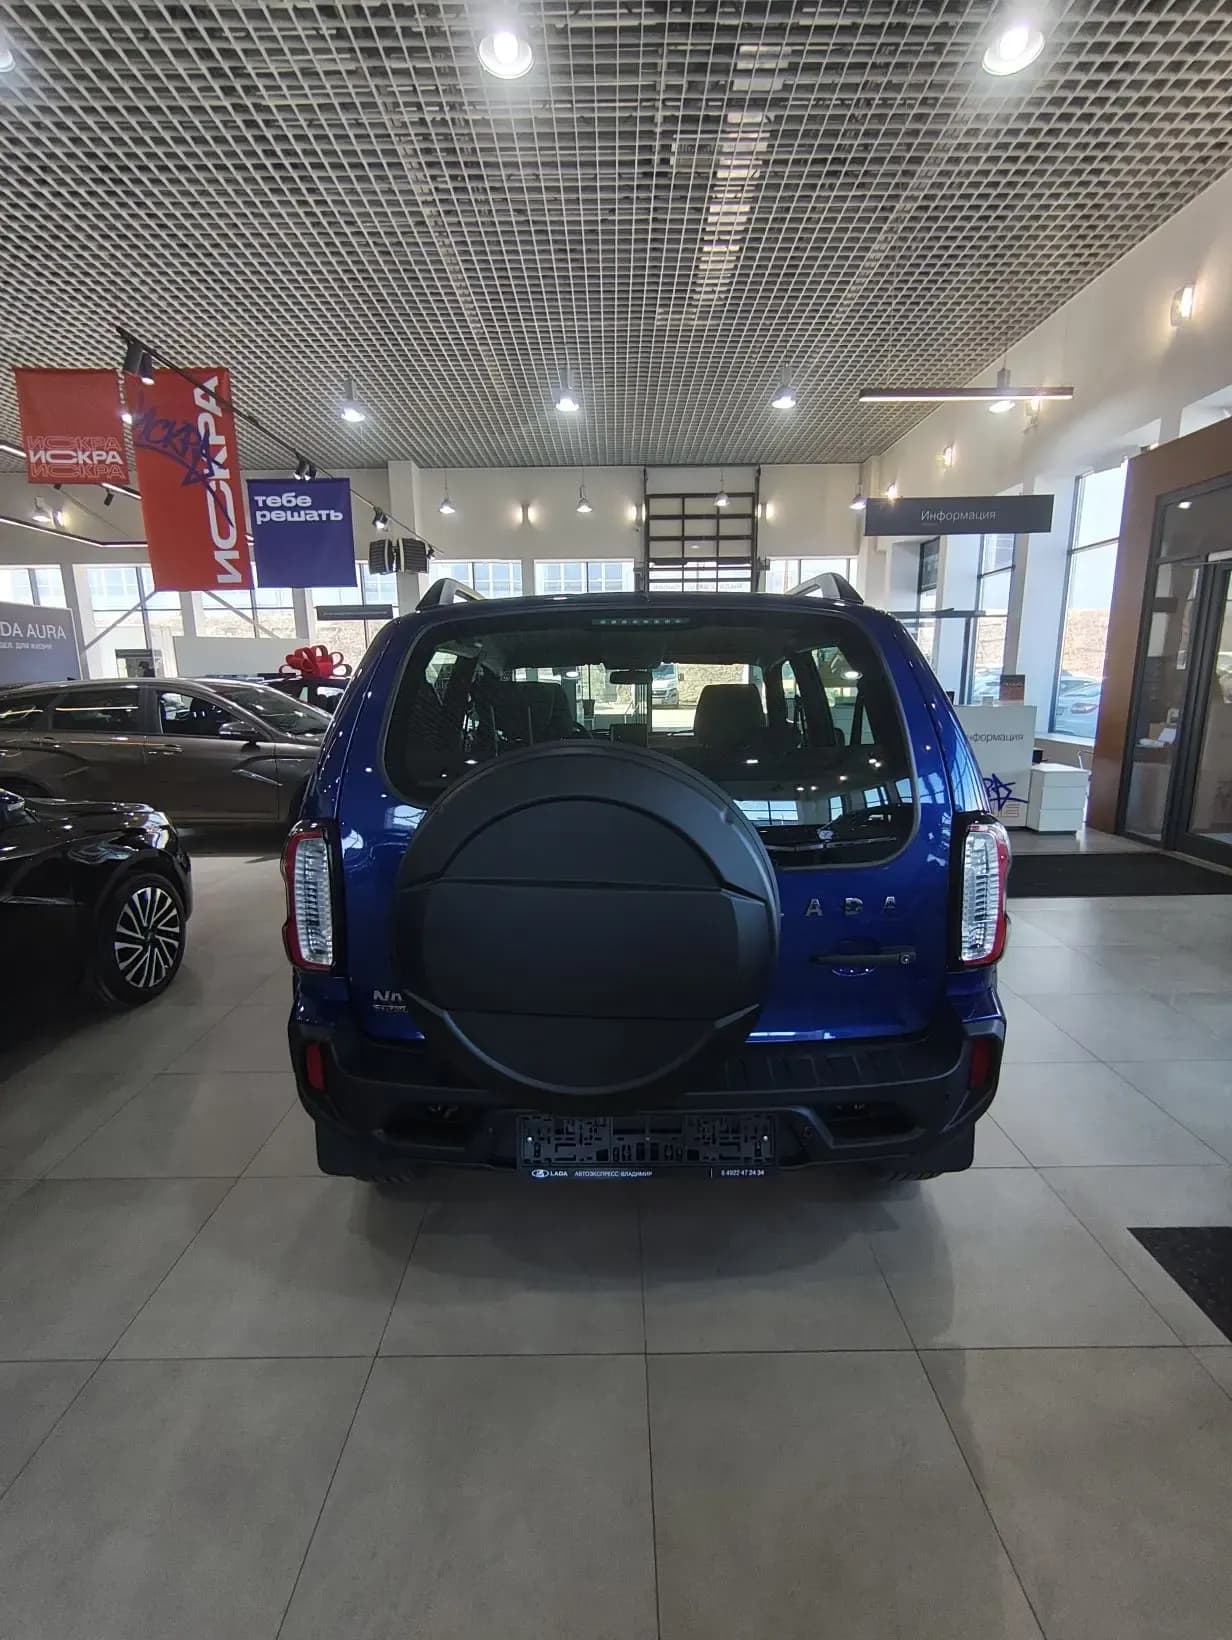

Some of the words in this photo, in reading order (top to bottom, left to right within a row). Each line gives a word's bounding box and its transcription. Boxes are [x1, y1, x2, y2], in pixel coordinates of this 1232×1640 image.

[27, 435, 122, 452] ИСКРА
[29, 450, 124, 465] ИСКРА
[31, 464, 127, 480] ИСКРА
[193, 376, 242, 584] ИСКРА
[254, 492, 312, 507] тебе
[255, 510, 343, 525] решать
[921, 510, 996, 525] Информация
[27, 623, 67, 640] AURA
[779, 896, 896, 917] ADA
